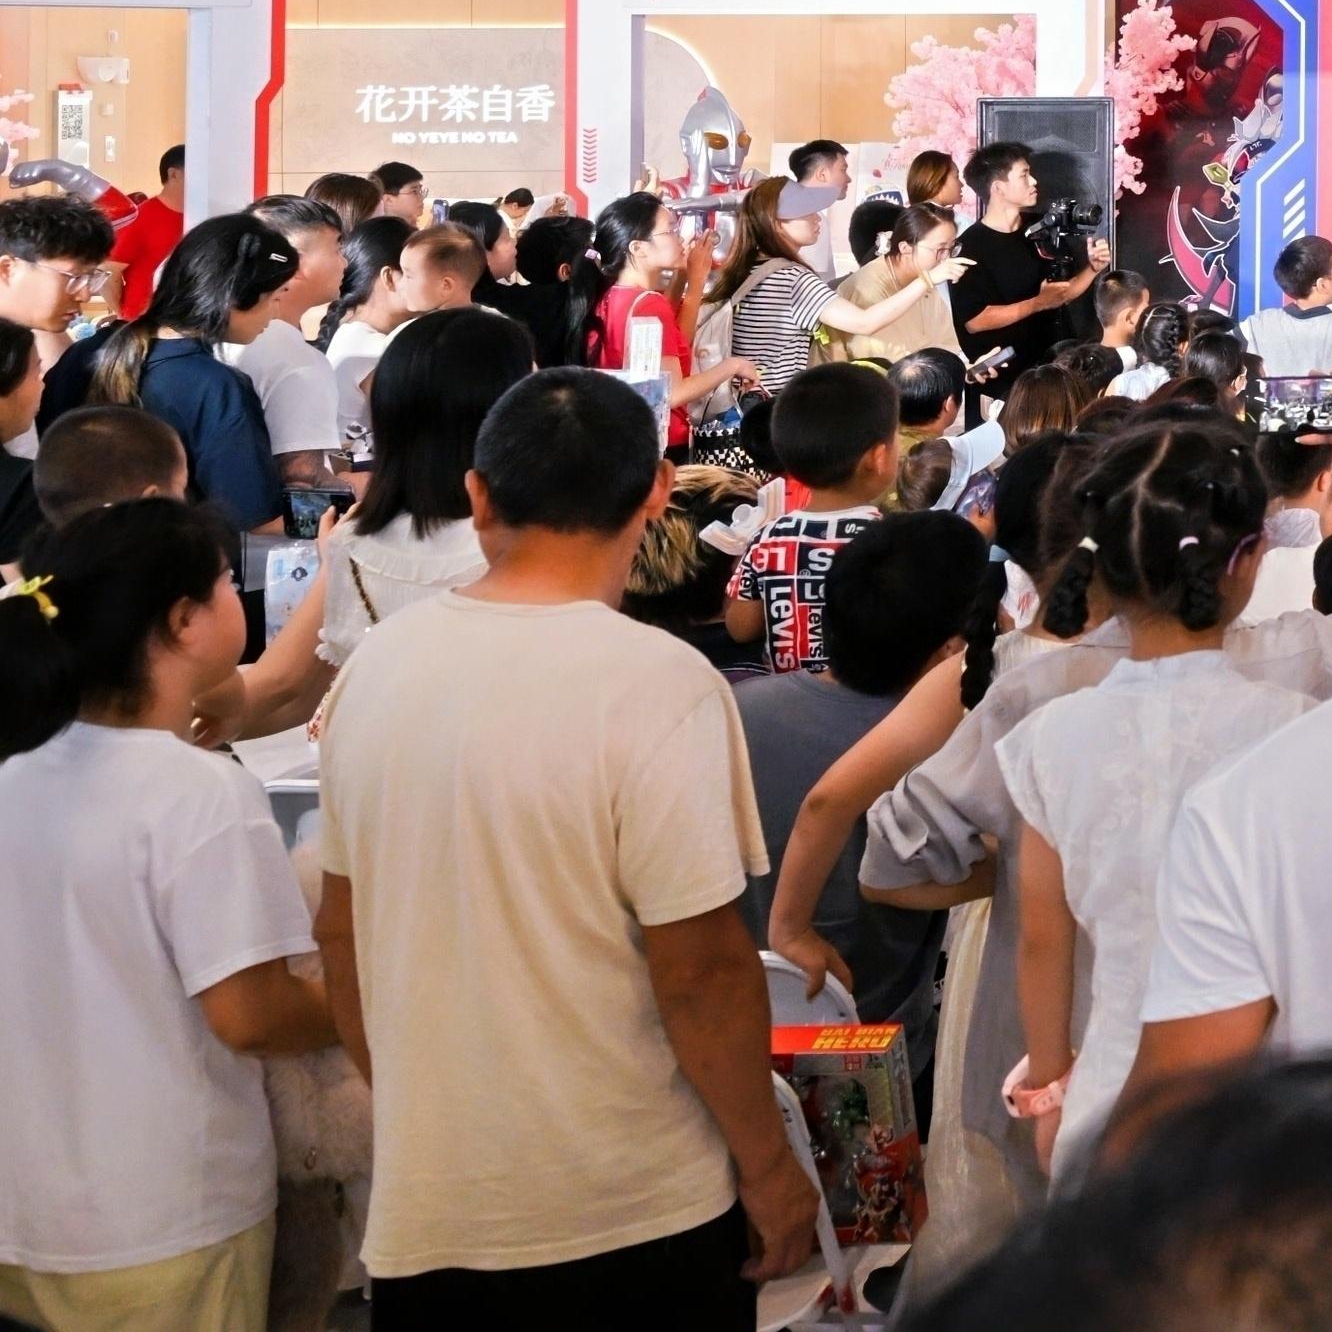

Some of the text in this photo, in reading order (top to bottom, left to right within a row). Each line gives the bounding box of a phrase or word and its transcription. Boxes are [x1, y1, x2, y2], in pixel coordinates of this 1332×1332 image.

[355, 85, 556, 124] 花开茶自香
[392, 132, 518, 144] NO YEYE NO TEA
